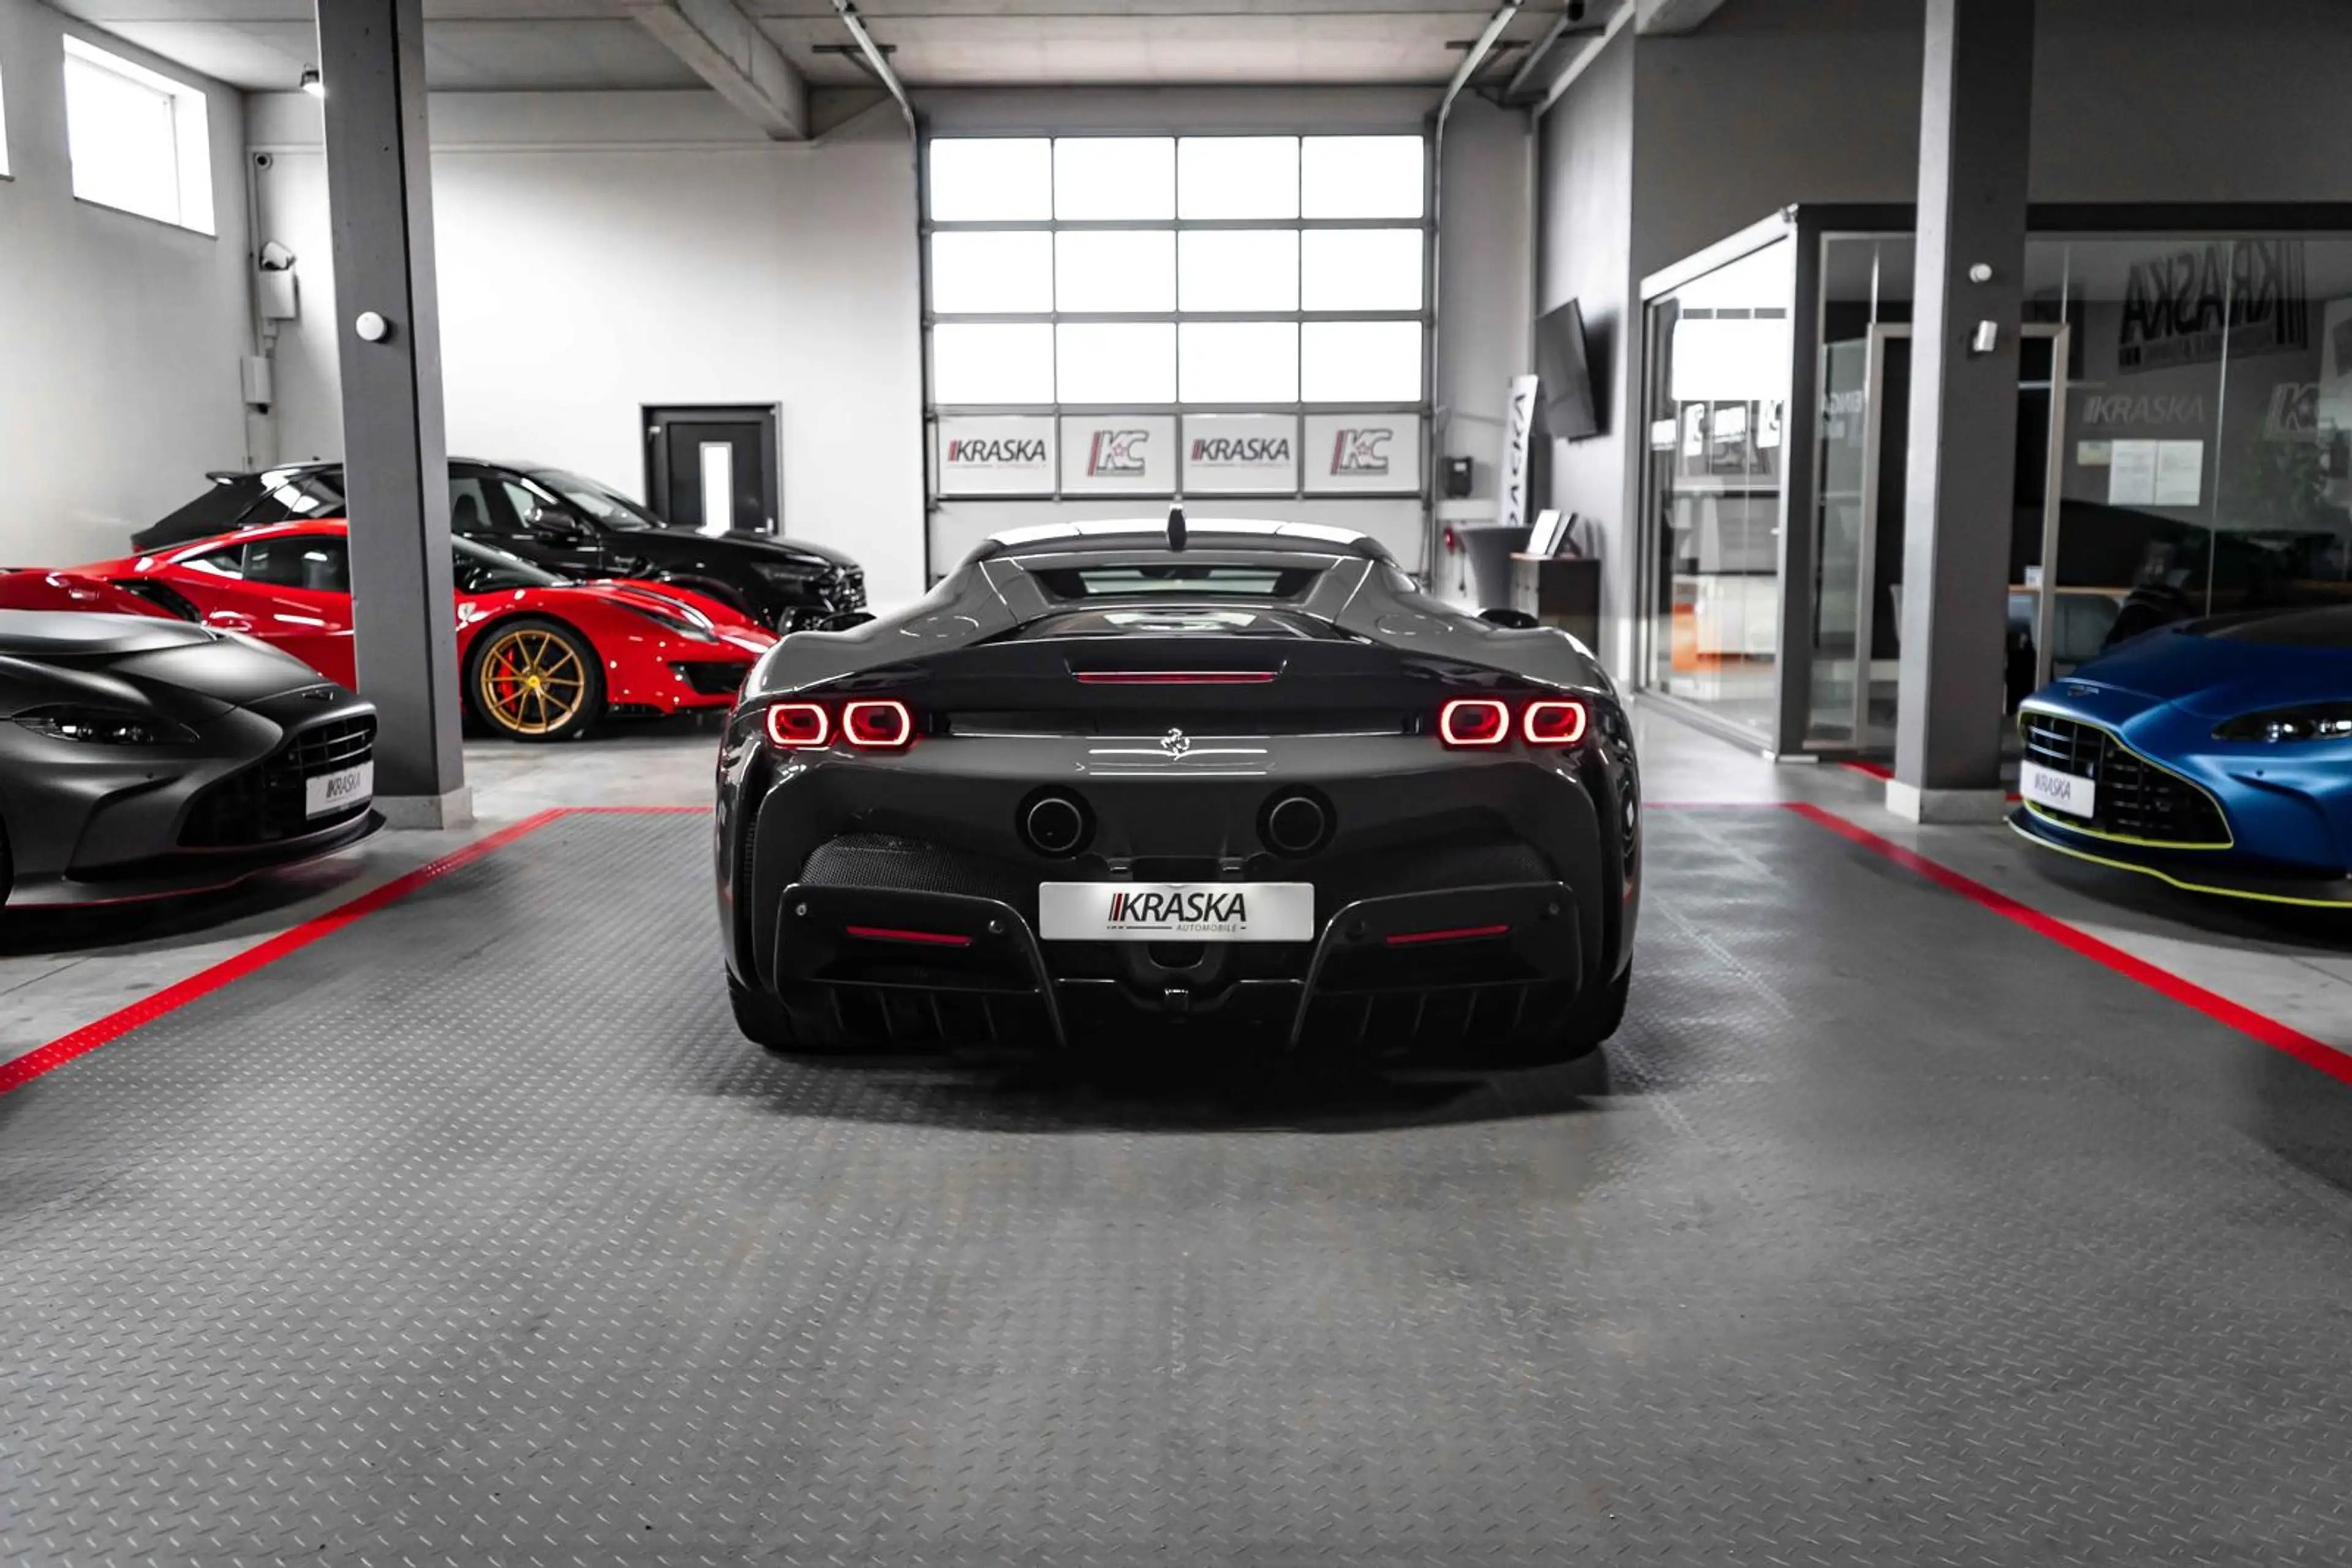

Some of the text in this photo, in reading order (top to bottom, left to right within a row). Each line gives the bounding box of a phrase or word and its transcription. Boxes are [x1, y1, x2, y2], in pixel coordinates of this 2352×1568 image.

[956, 439, 1046, 462] KRASKA
[1200, 438, 1290, 461] KRASKA
[1119, 893, 1246, 922] KRASKA
[1175, 923, 1237, 933] AUTOMOBILE
